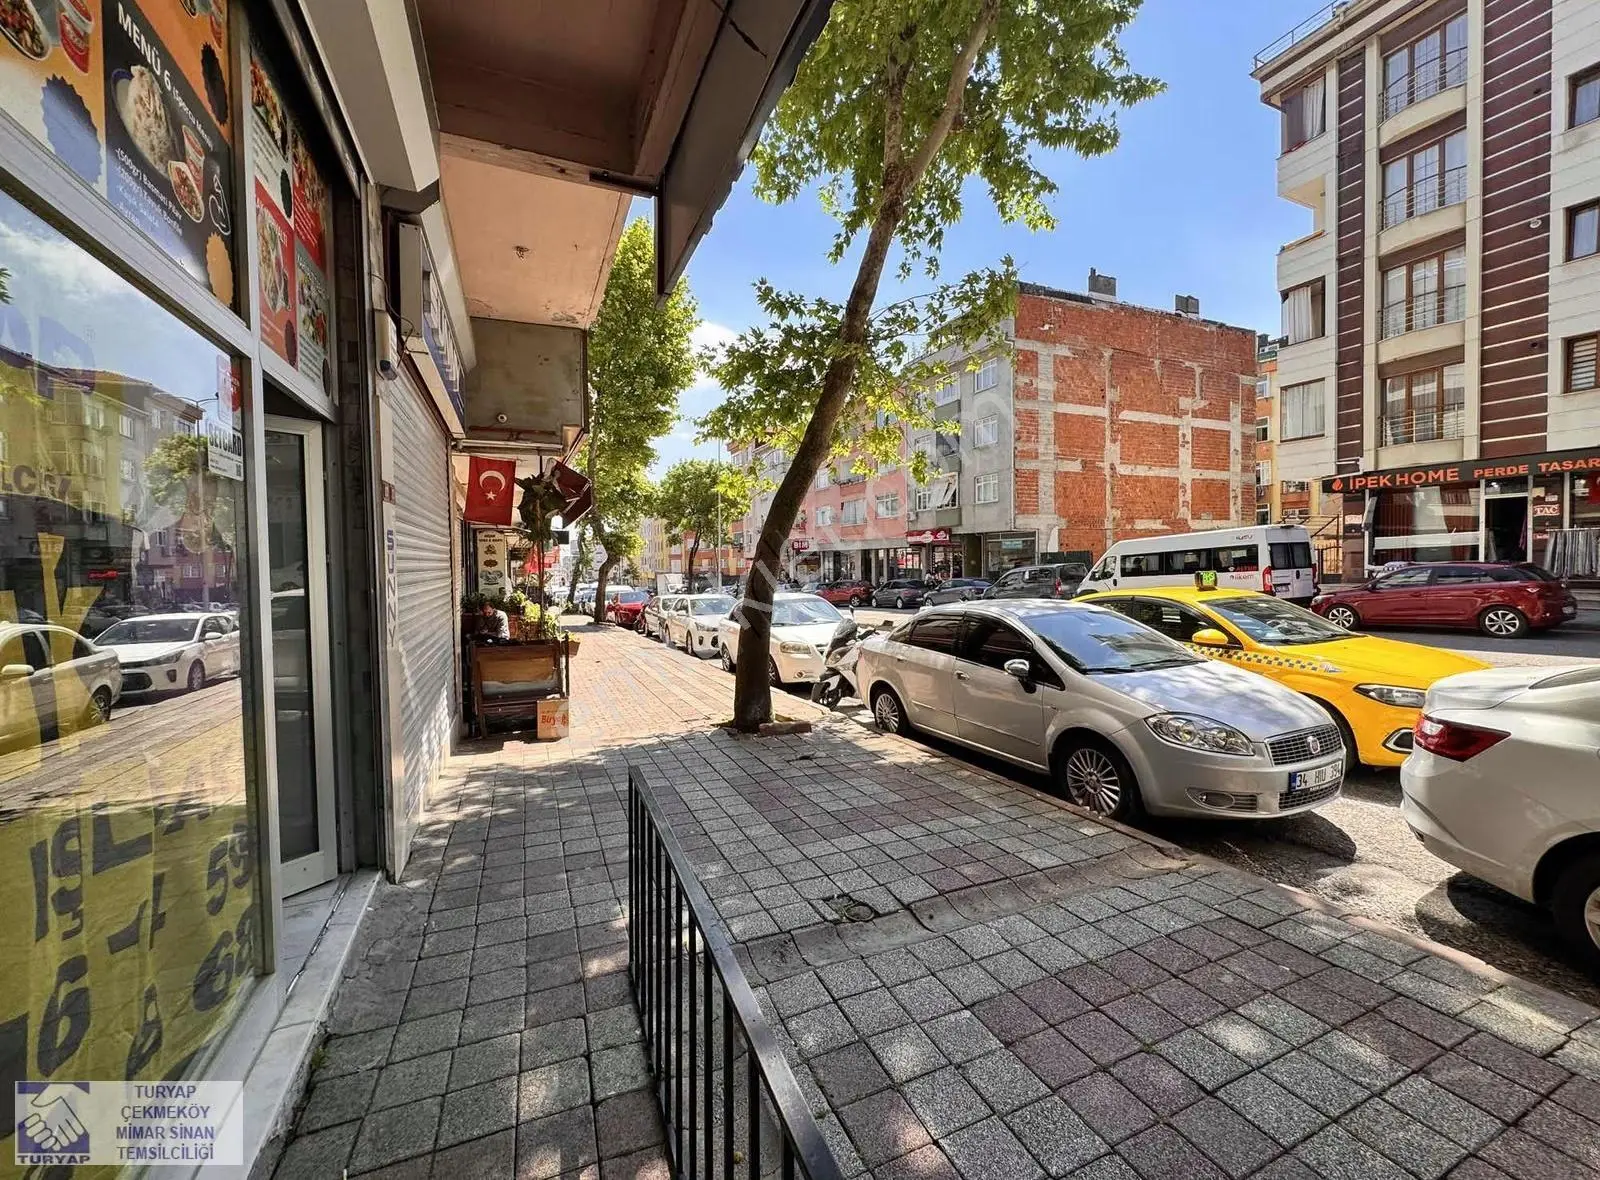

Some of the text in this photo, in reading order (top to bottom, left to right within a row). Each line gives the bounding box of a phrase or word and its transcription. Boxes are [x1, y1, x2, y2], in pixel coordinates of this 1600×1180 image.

[118, 1, 161, 76] MENÜ
[163, 69, 172, 92] 6
[1396, 468, 1460, 486] HOME
[1473, 464, 1529, 479] PERDE
[387, 529, 397, 647] SUNNY
